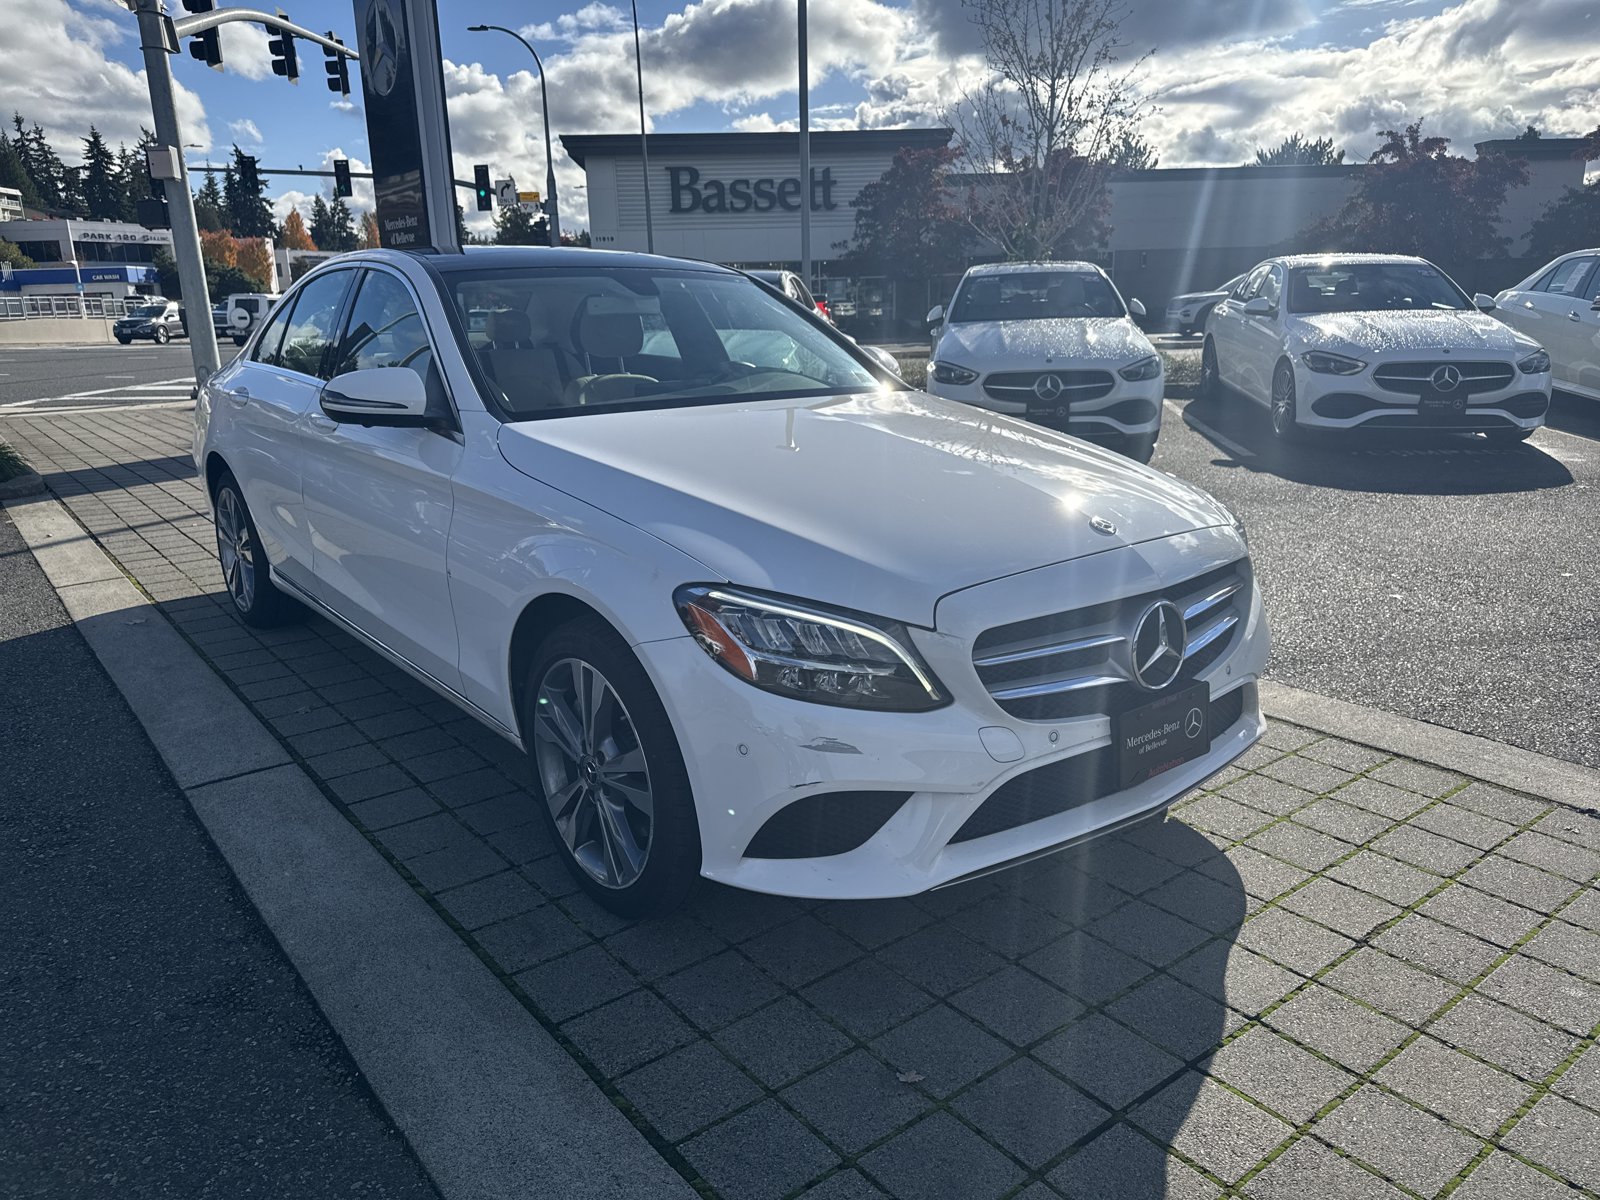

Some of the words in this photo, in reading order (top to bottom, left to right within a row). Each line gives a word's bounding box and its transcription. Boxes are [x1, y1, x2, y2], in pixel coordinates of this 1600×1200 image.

[665, 166, 837, 213] Bassett
[83, 232, 112, 240] PARK
[1127, 721, 1180, 749] Mercedes-Benz
[1139, 747, 1145, 755] of
[1145, 739, 1168, 752] Bellevue
